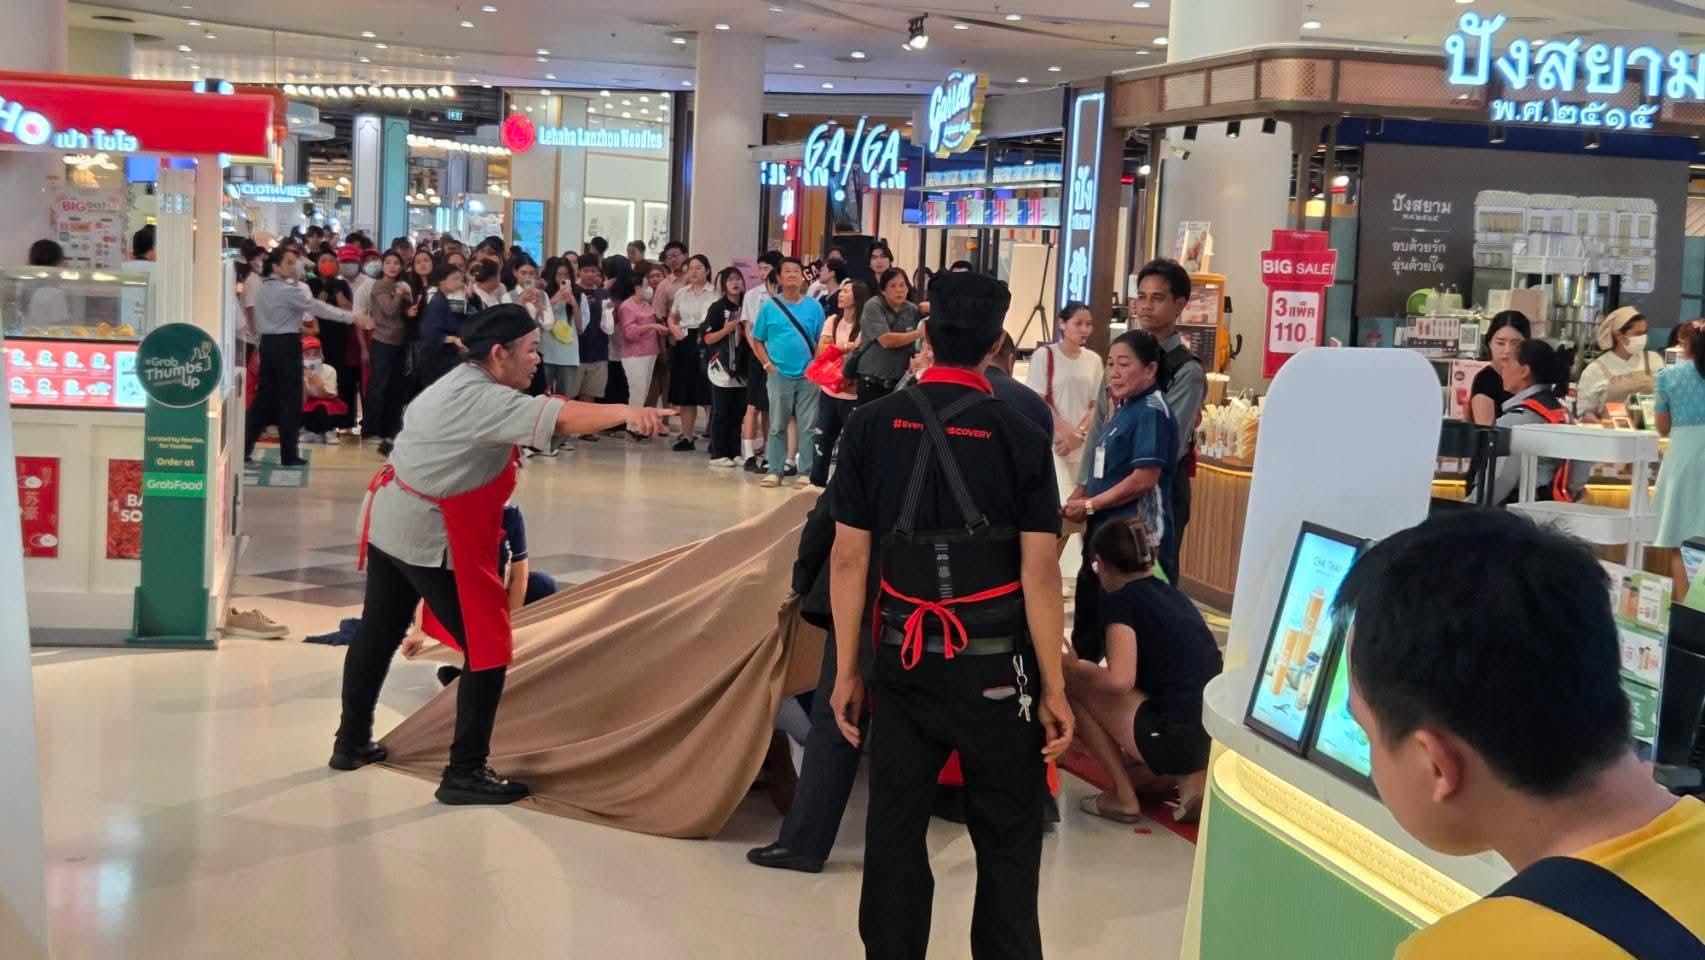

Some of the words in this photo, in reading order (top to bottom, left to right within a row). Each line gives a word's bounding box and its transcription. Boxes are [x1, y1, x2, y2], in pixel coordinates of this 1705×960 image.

[1445, 11, 1705, 100] ปังสยาม
[1490, 99, 1659, 130] พ.ศ.๒๕๑๕
[621, 128, 663, 149] Noodles
[1391, 193, 1451, 214] ปังสยาม
[1262, 260, 1293, 275] BIG
[1296, 263, 1335, 276] SALE!
[1274, 297, 1288, 317] 3
[145, 361, 203, 380] Thumbs
[157, 457, 182, 466] Order
[184, 459, 195, 467] at
[147, 479, 203, 490] GrabFood
